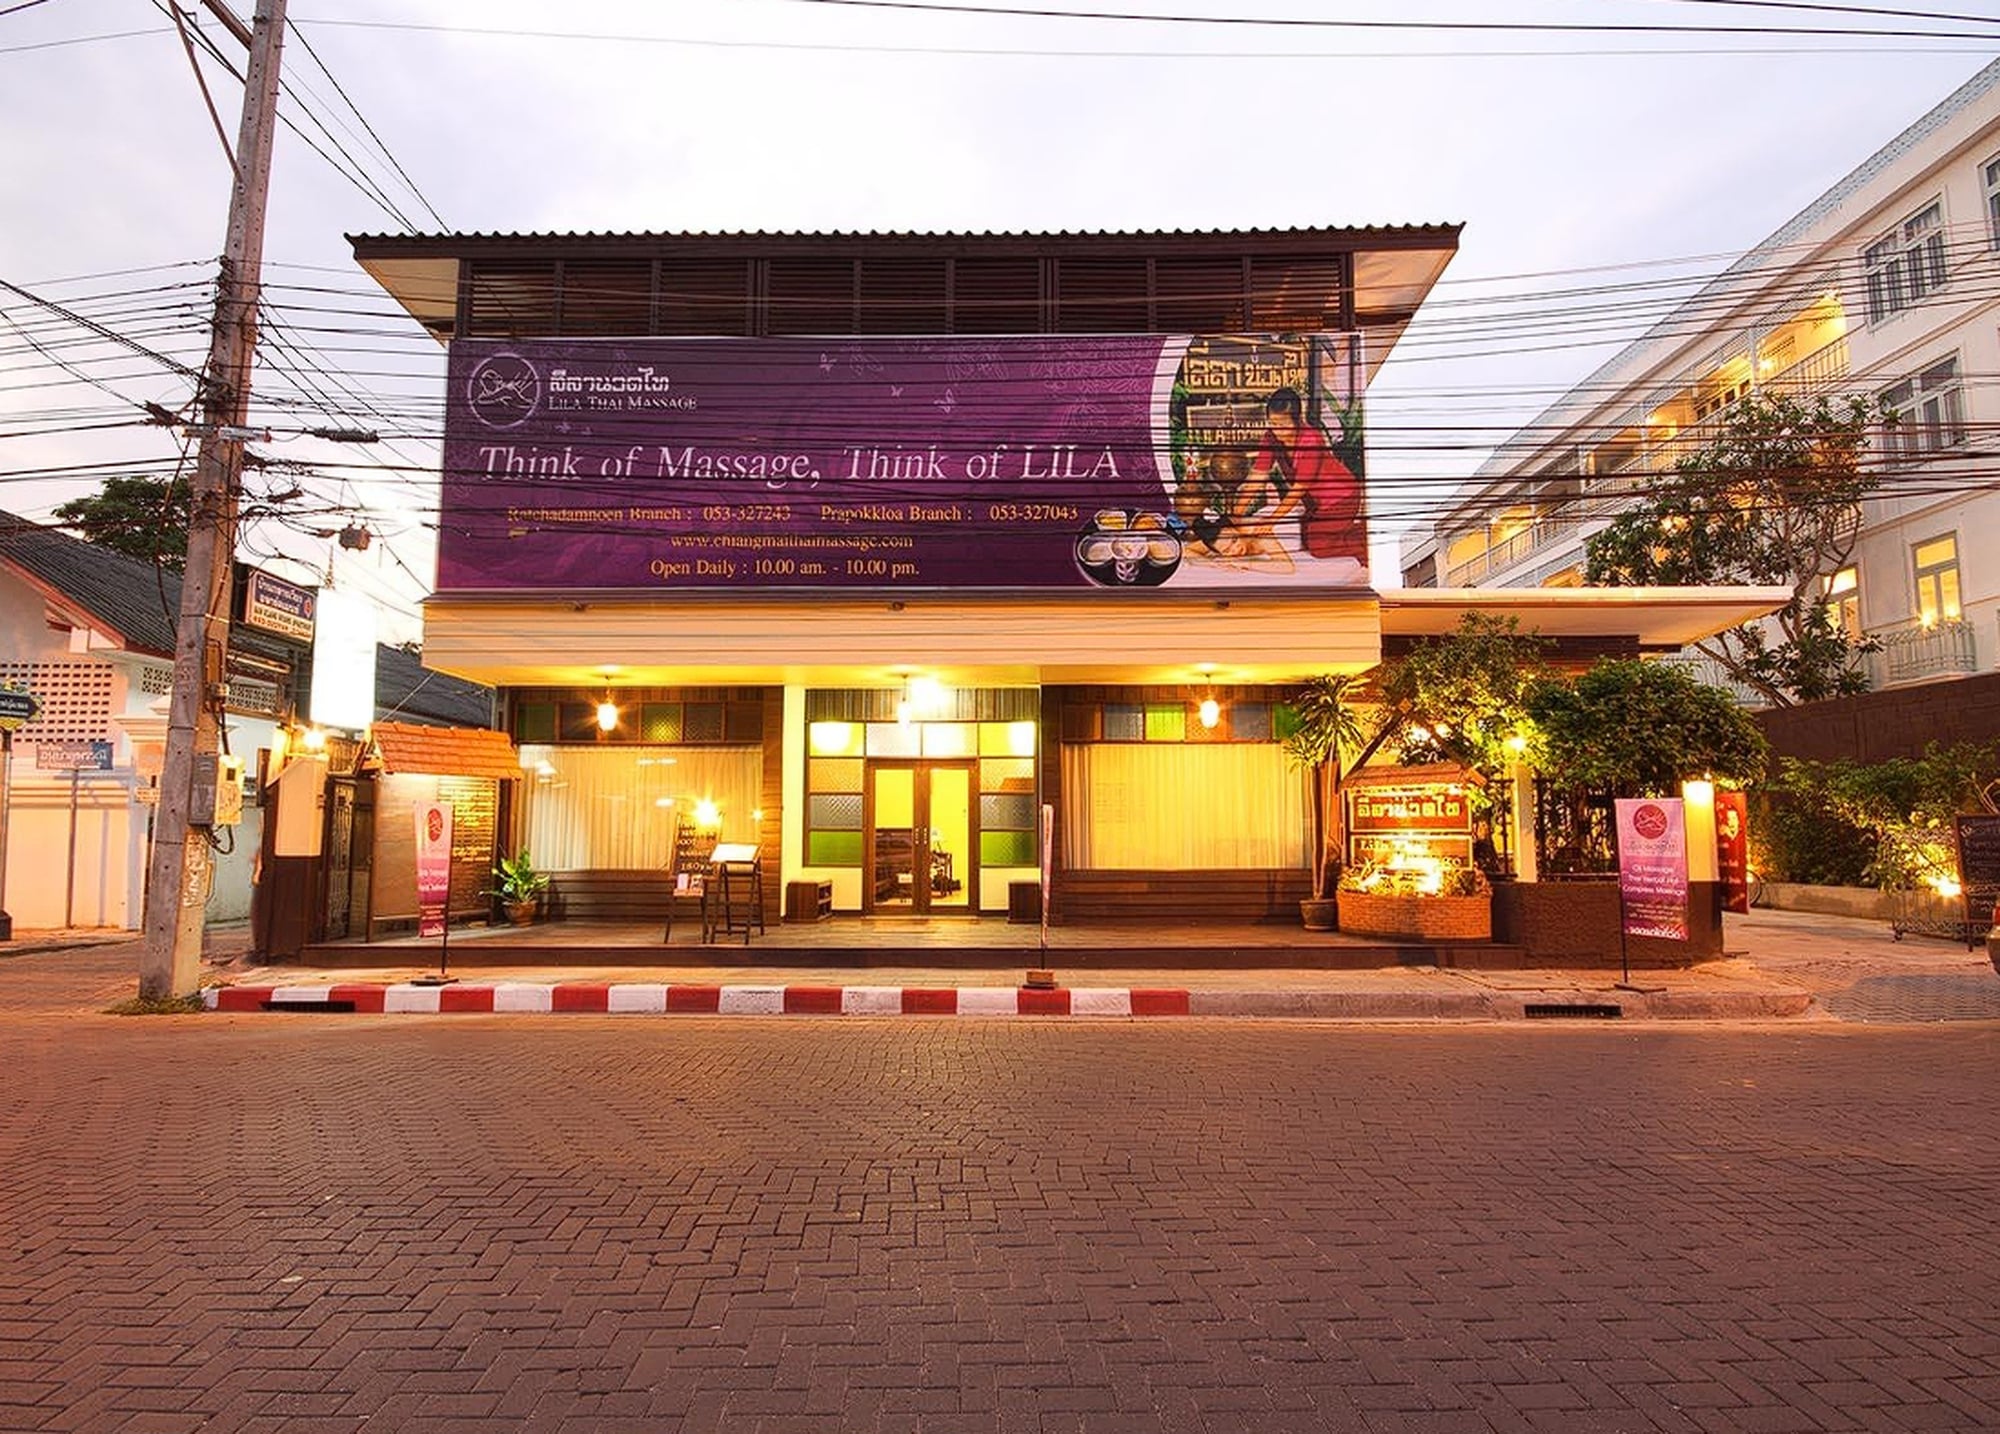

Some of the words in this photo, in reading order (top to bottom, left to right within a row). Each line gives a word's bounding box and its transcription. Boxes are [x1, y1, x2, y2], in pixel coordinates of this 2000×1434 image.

[587, 396, 622, 410] THAI
[628, 396, 697, 410] MASSAGE
[479, 446, 583, 481] Think
[600, 446, 643, 481] of
[657, 446, 821, 489] Massage,
[843, 445, 948, 479] Think
[966, 445, 1008, 479] of
[1019, 446, 1121, 479] LILA
[630, 507, 681, 520] Branch
[909, 506, 962, 521] Branch
[990, 505, 1078, 520] 053-327043
[651, 560, 690, 578] Open
[697, 559, 735, 577] Daily
[754, 559, 794, 575] 10.00
[800, 563, 827, 575] am.
[846, 559, 887, 575] 10.00
[892, 563, 920, 578] pm.
